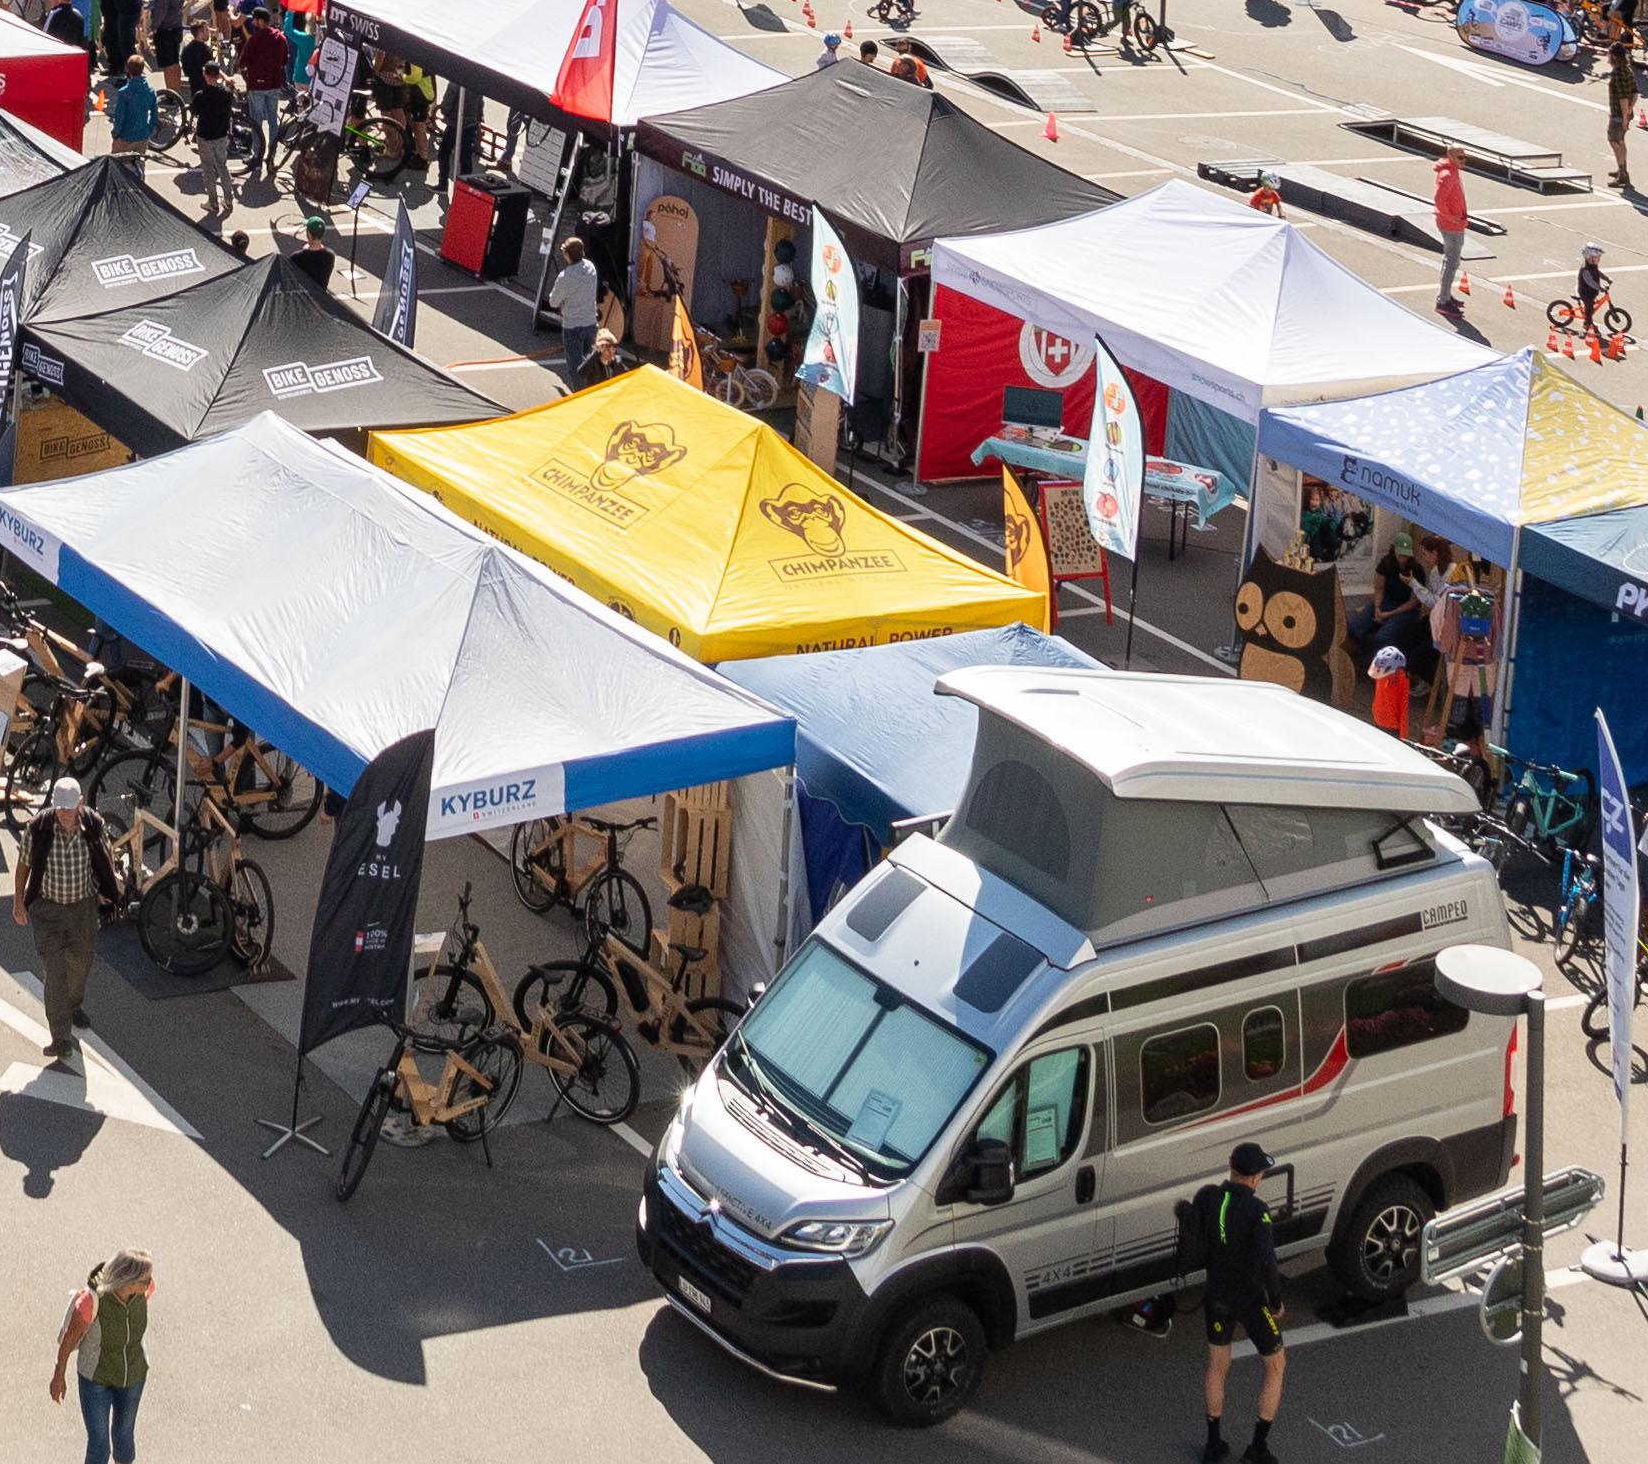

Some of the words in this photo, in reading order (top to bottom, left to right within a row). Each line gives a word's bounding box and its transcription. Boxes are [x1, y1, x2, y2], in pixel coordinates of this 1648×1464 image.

[330, 7, 347, 24] DT
[350, 14, 380, 41] SWISS
[712, 166, 754, 200] SIMPLY
[758, 186, 780, 211] THE
[783, 194, 812, 226] BEST
[100, 259, 133, 277] BIKE
[139, 252, 194, 277] GENOSS
[271, 369, 305, 388] BIKE
[314, 362, 370, 387] GENOSS
[43, 441, 64, 456] BIKE
[70, 436, 105, 453] GENOSS
[543, 468, 635, 521] CHIMPANZEE
[1361, 466, 1421, 507] namuk
[0, 507, 44, 555] KYBURZ
[782, 556, 893, 576] CHIMPANZEE
[441, 779, 536, 817] KYBURZ
[482, 801, 536, 818] SWITZERLAND
[358, 862, 401, 879] ESEL
[376, 854, 386, 862] MY
[1423, 900, 1468, 925] CAMPEO
